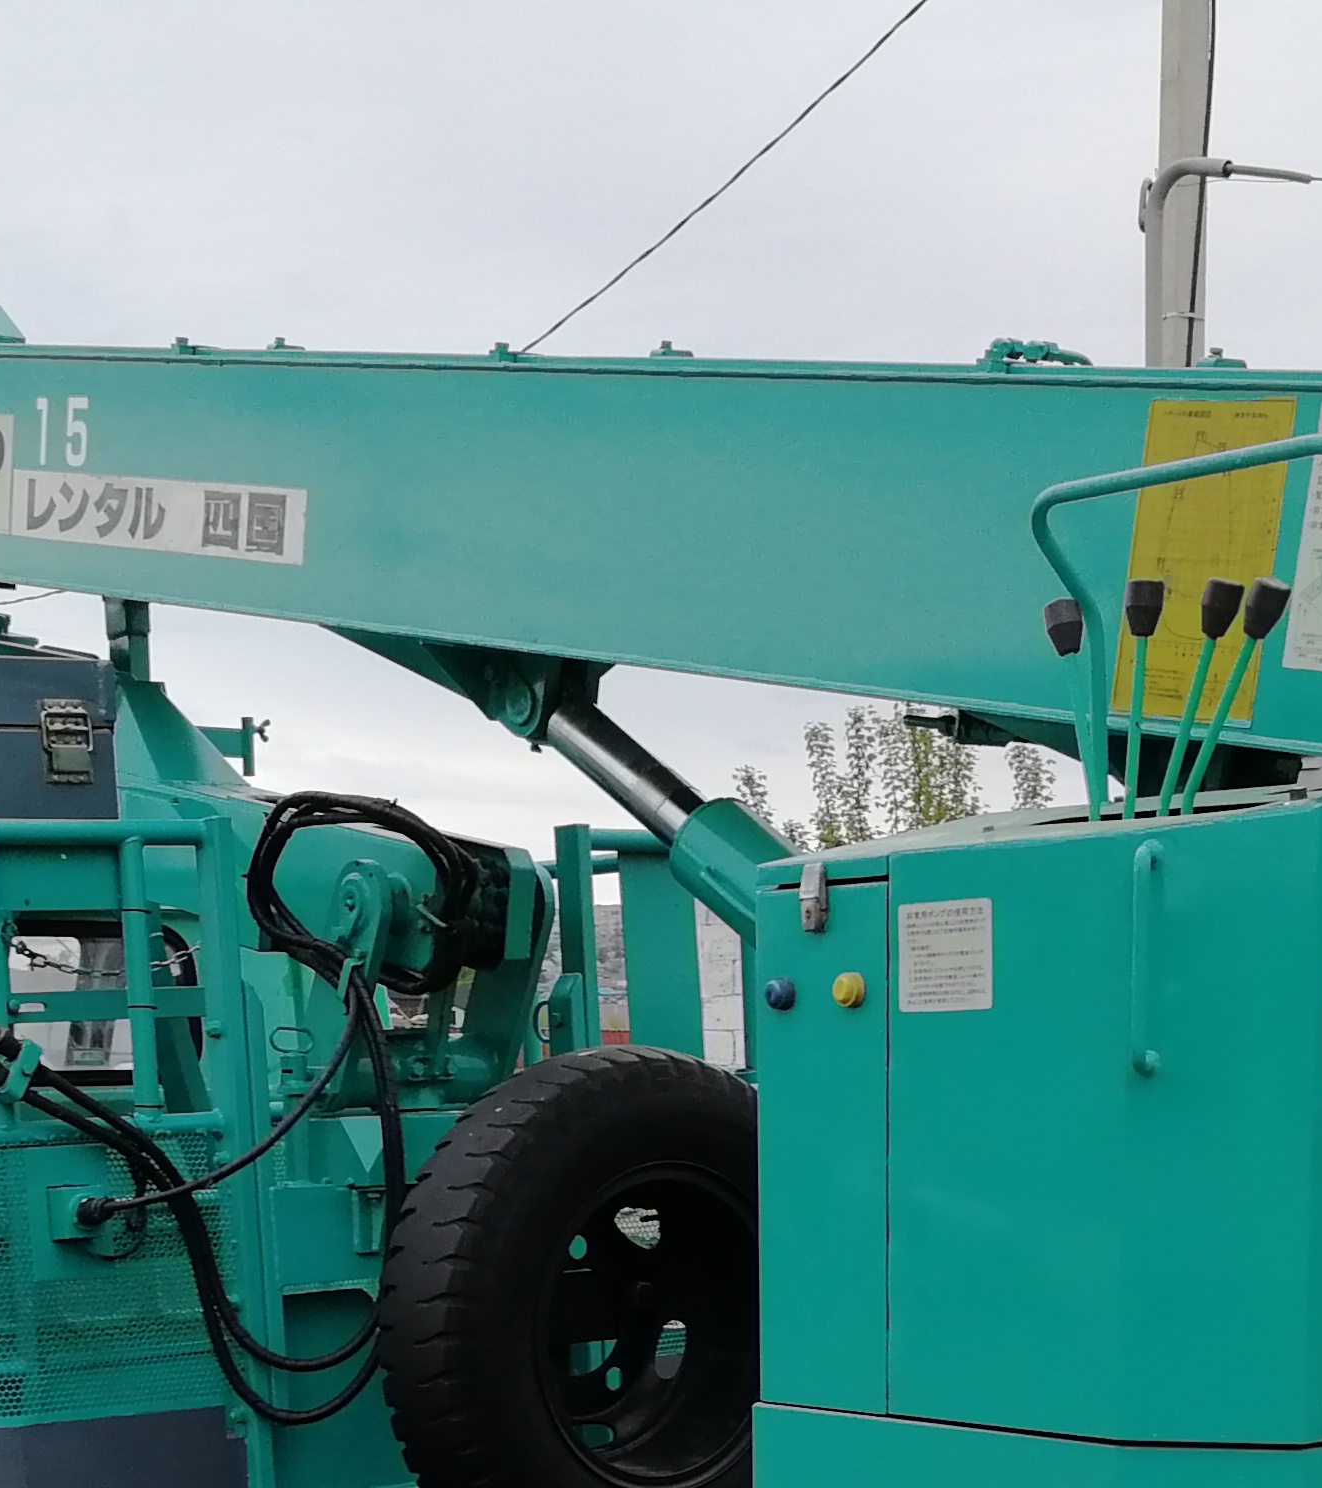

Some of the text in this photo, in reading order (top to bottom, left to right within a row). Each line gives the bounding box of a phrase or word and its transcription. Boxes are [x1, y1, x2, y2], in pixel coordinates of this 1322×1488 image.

[36, 395, 89, 467] 15
[26, 477, 288, 556] レンタル 四国
